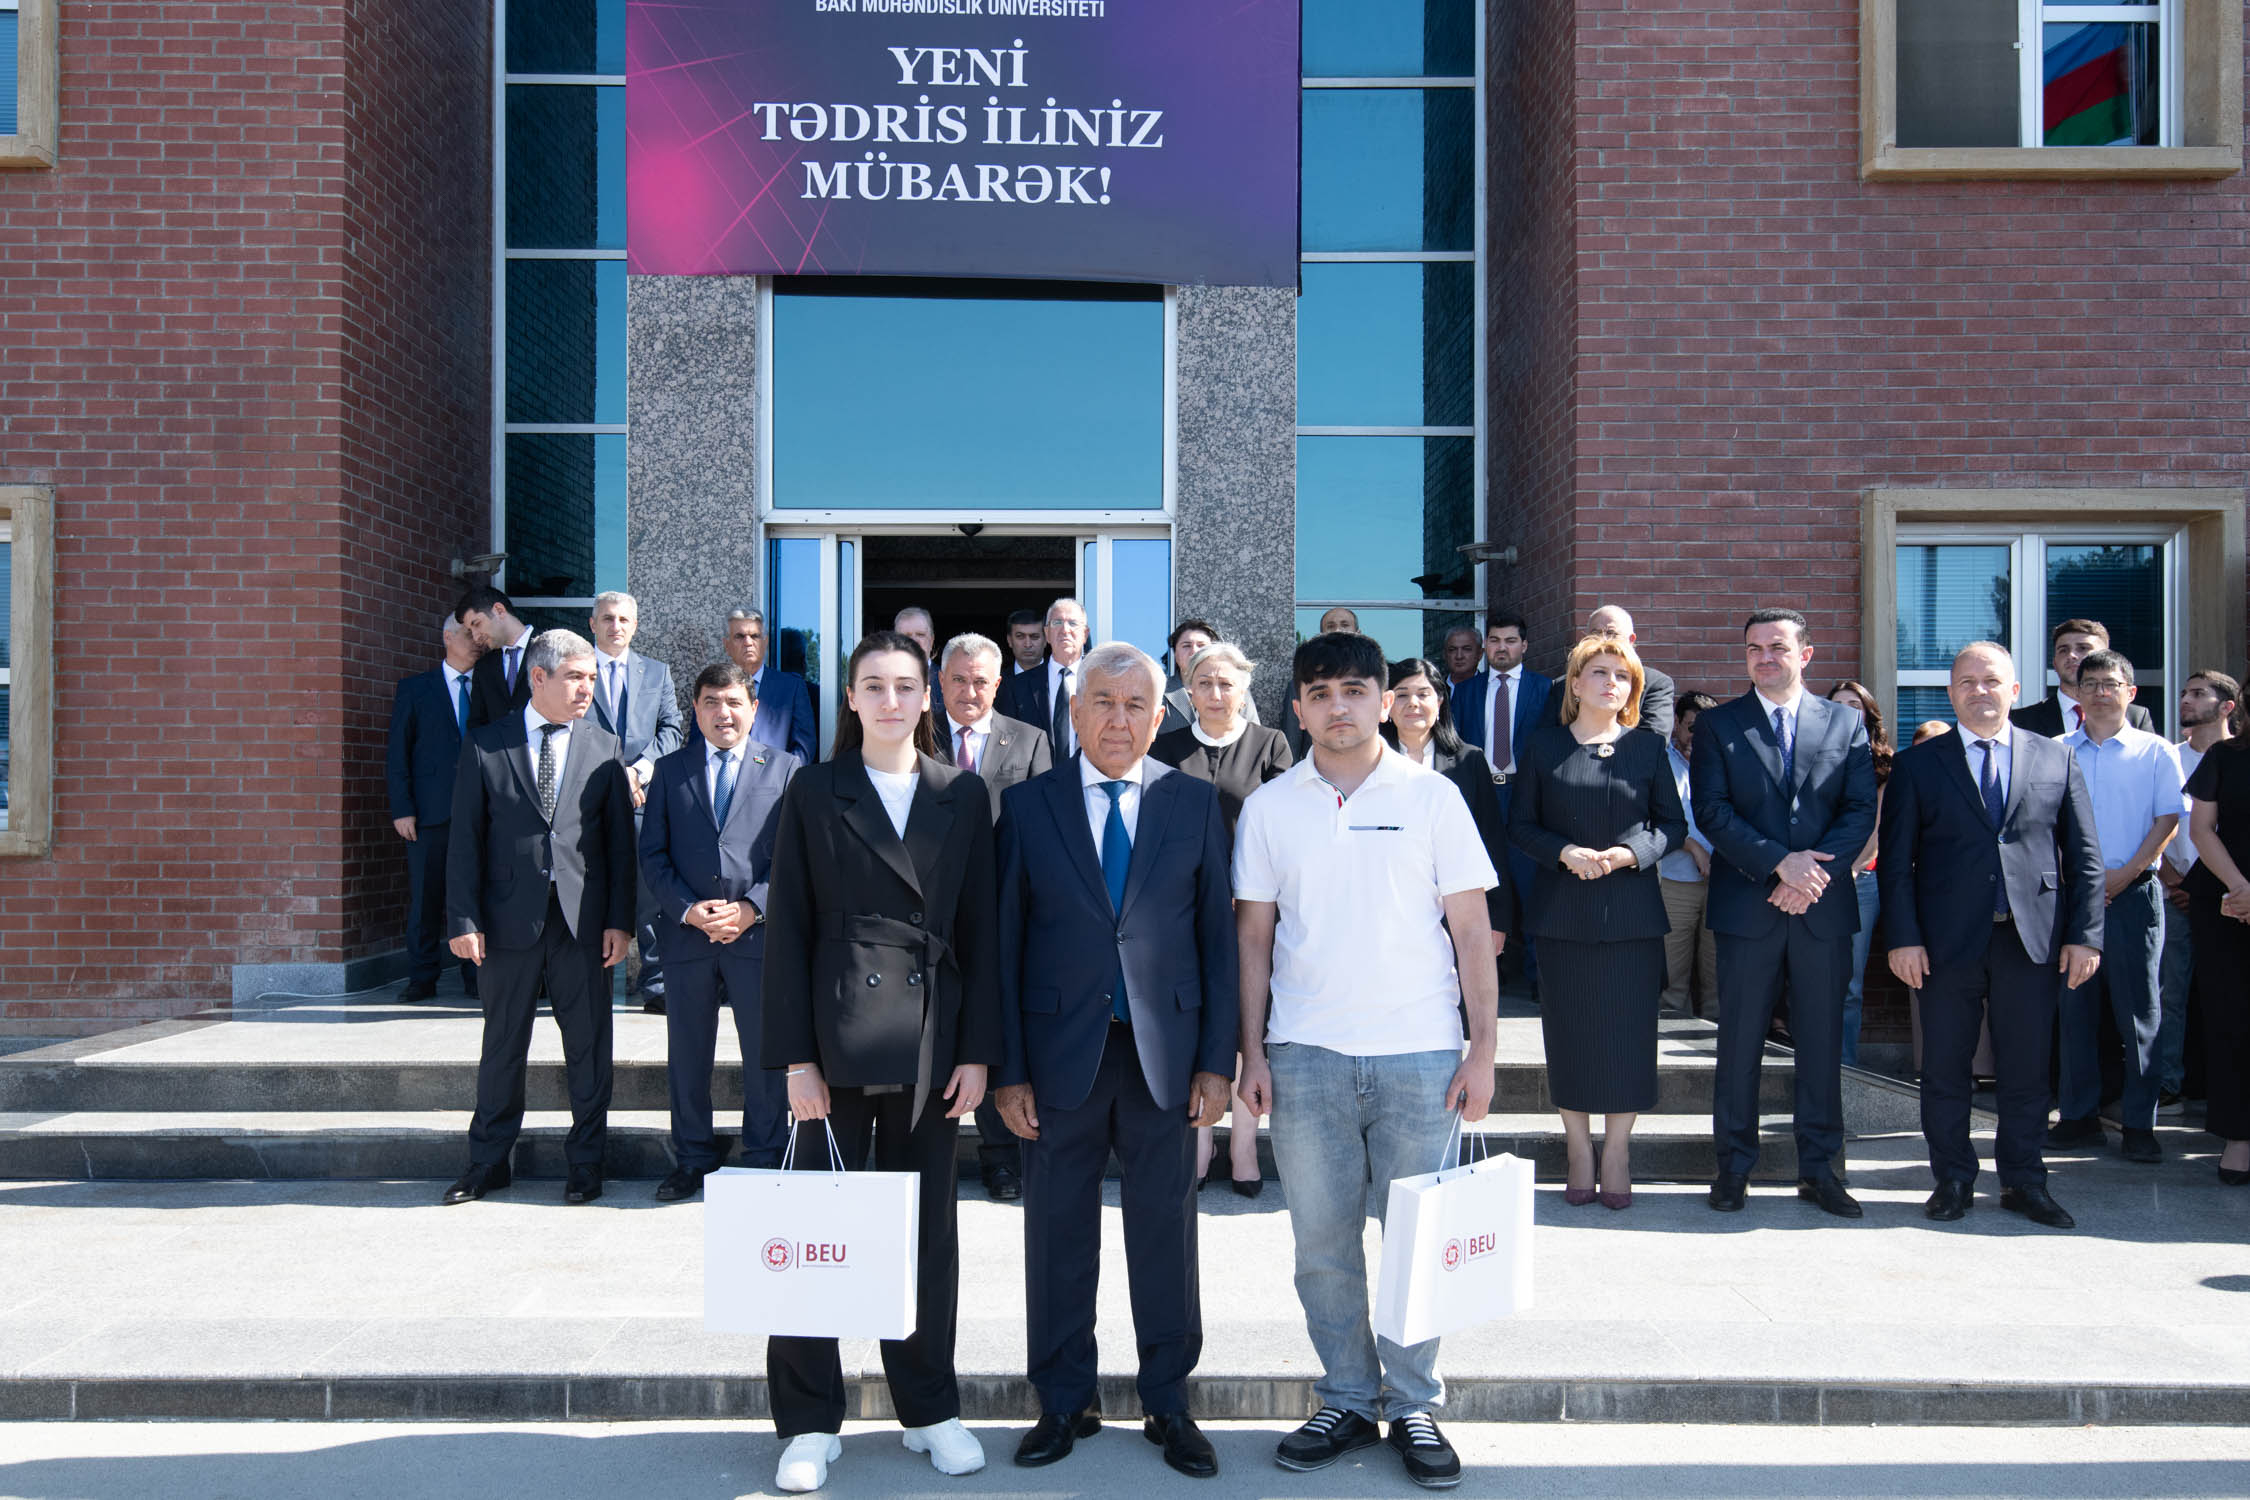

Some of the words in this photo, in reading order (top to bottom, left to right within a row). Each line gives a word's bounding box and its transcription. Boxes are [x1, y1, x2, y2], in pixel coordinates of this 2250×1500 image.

[815, 0, 857, 12] BAKI
[887, 38, 1029, 87] YENİ
[753, 94, 968, 144] TƏDRİS
[982, 95, 1163, 148] İLİNİZ
[800, 151, 1111, 205] MÜBARƏK!
[805, 1243, 847, 1263] BEU
[1469, 1232, 1496, 1256] BEU
